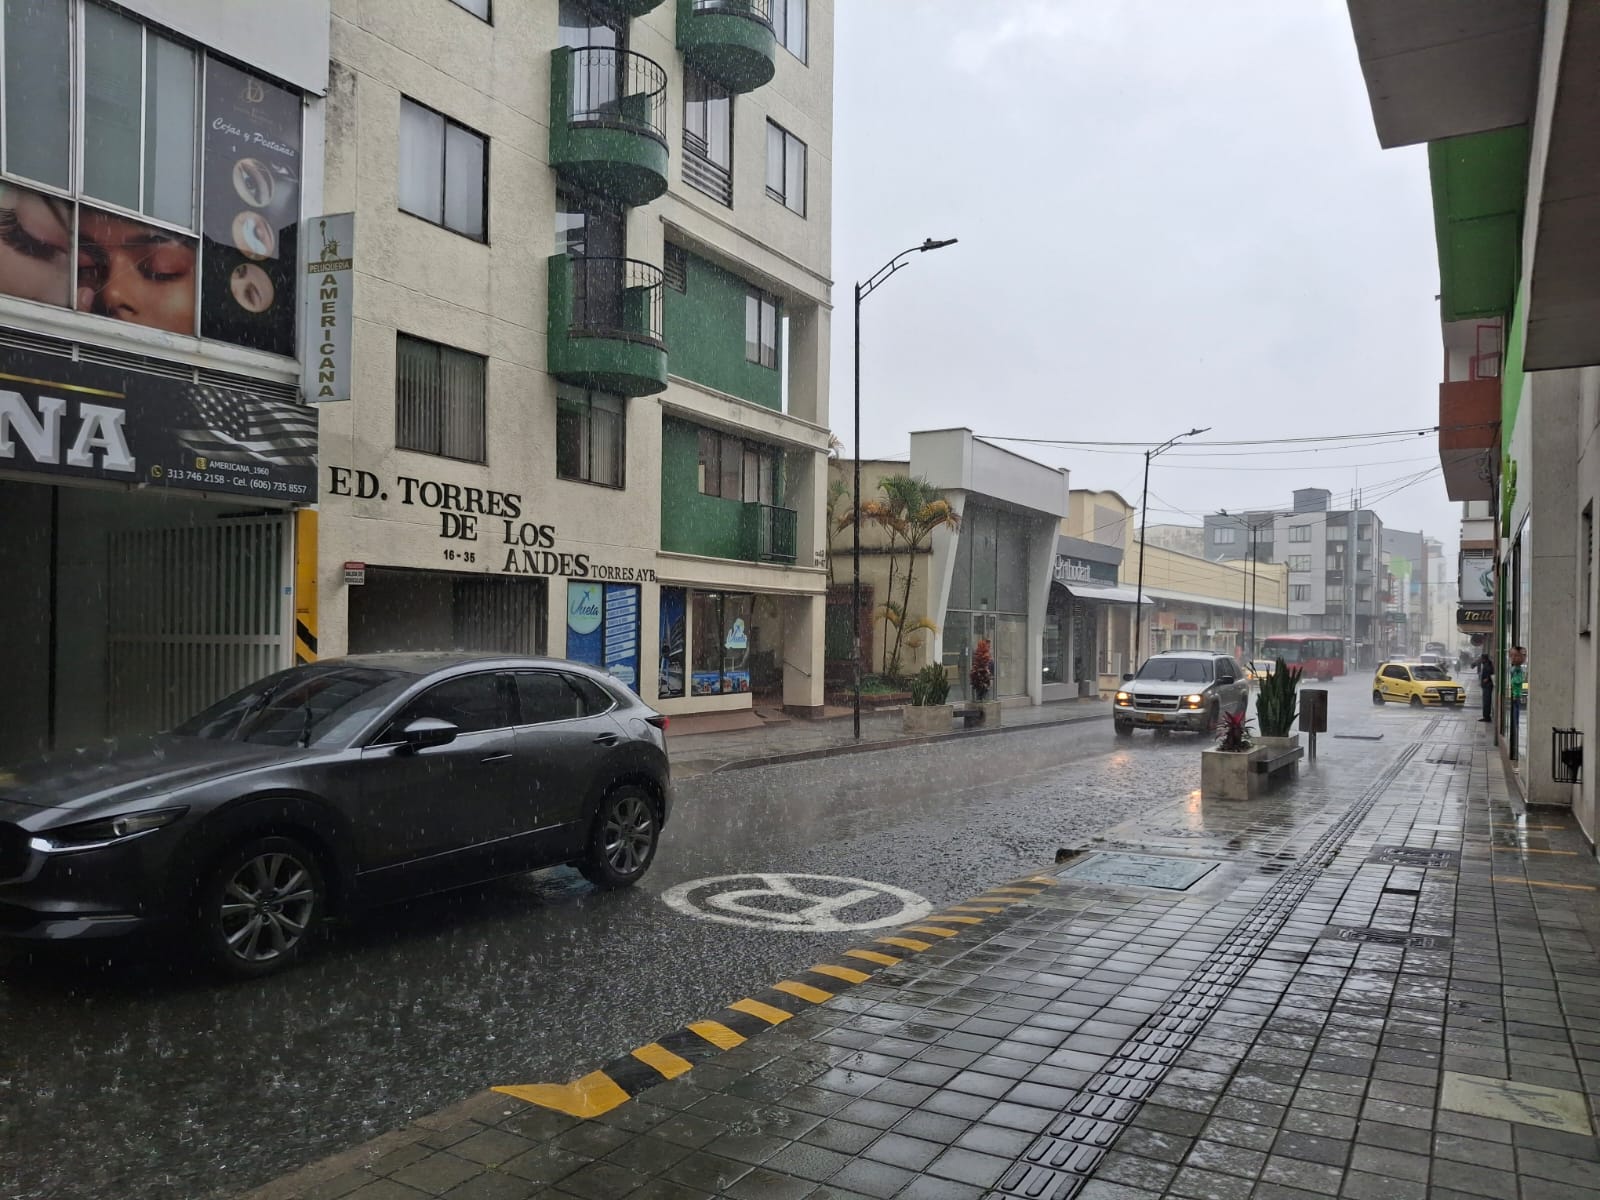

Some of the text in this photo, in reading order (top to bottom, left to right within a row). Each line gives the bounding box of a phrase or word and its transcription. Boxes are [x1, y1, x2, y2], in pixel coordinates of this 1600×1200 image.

[318, 273, 338, 397] AMERICANA
[167, 468, 184, 479] 313
[186, 470, 202, 481] 746
[204, 473, 225, 484] 2158
[233, 476, 248, 487] Cel.
[250, 478, 271, 491] (606)
[273, 481, 287, 492] 735
[288, 483, 307, 494] 8557
[209, 462, 269, 475] AMERICANA_1960
[328, 465, 521, 519] ED. TORRES
[439, 511, 556, 548] DE LOS
[502, 548, 590, 578] ANDES
[591, 564, 634, 580] TORRES
